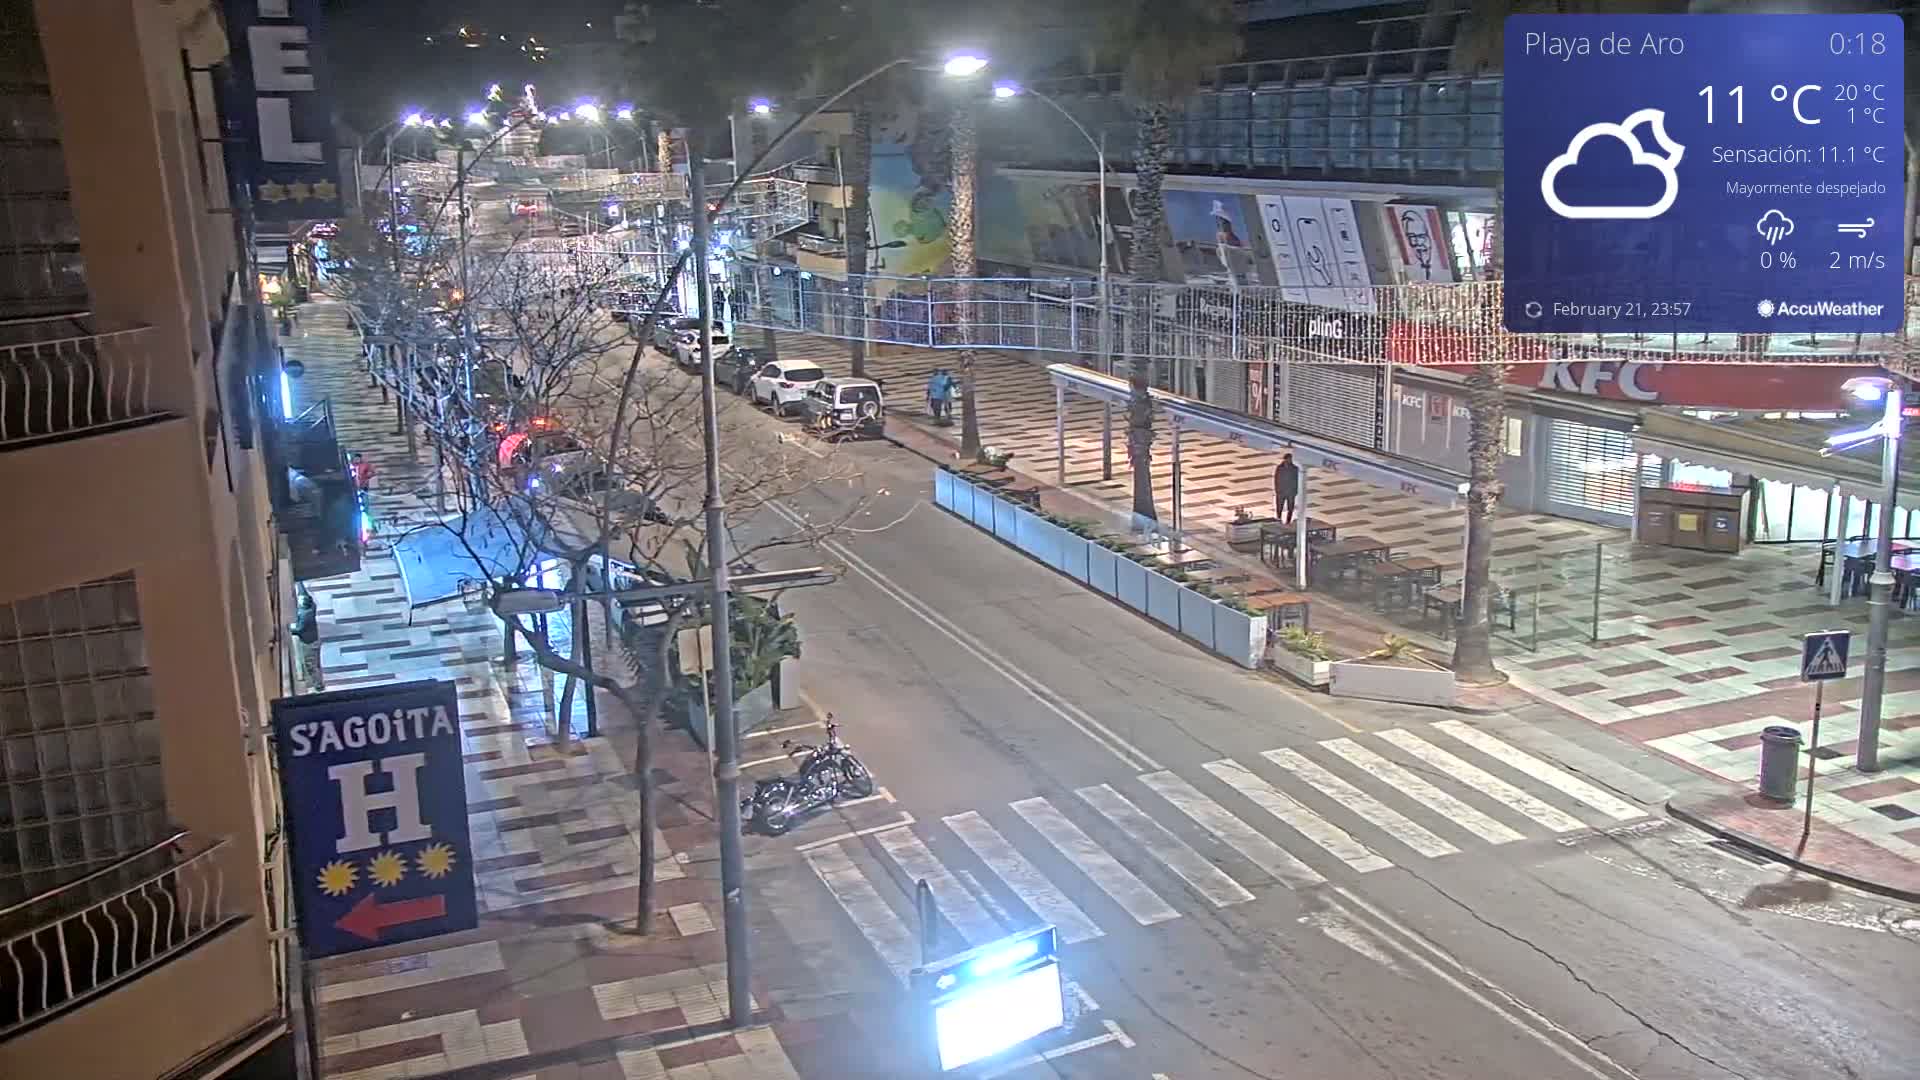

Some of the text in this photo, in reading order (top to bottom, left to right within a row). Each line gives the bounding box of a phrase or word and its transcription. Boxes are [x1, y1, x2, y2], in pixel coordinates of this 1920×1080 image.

[1402, 394, 1422, 408] KFC
[1538, 354, 1663, 401] KFC
[328, 752, 433, 854] H
